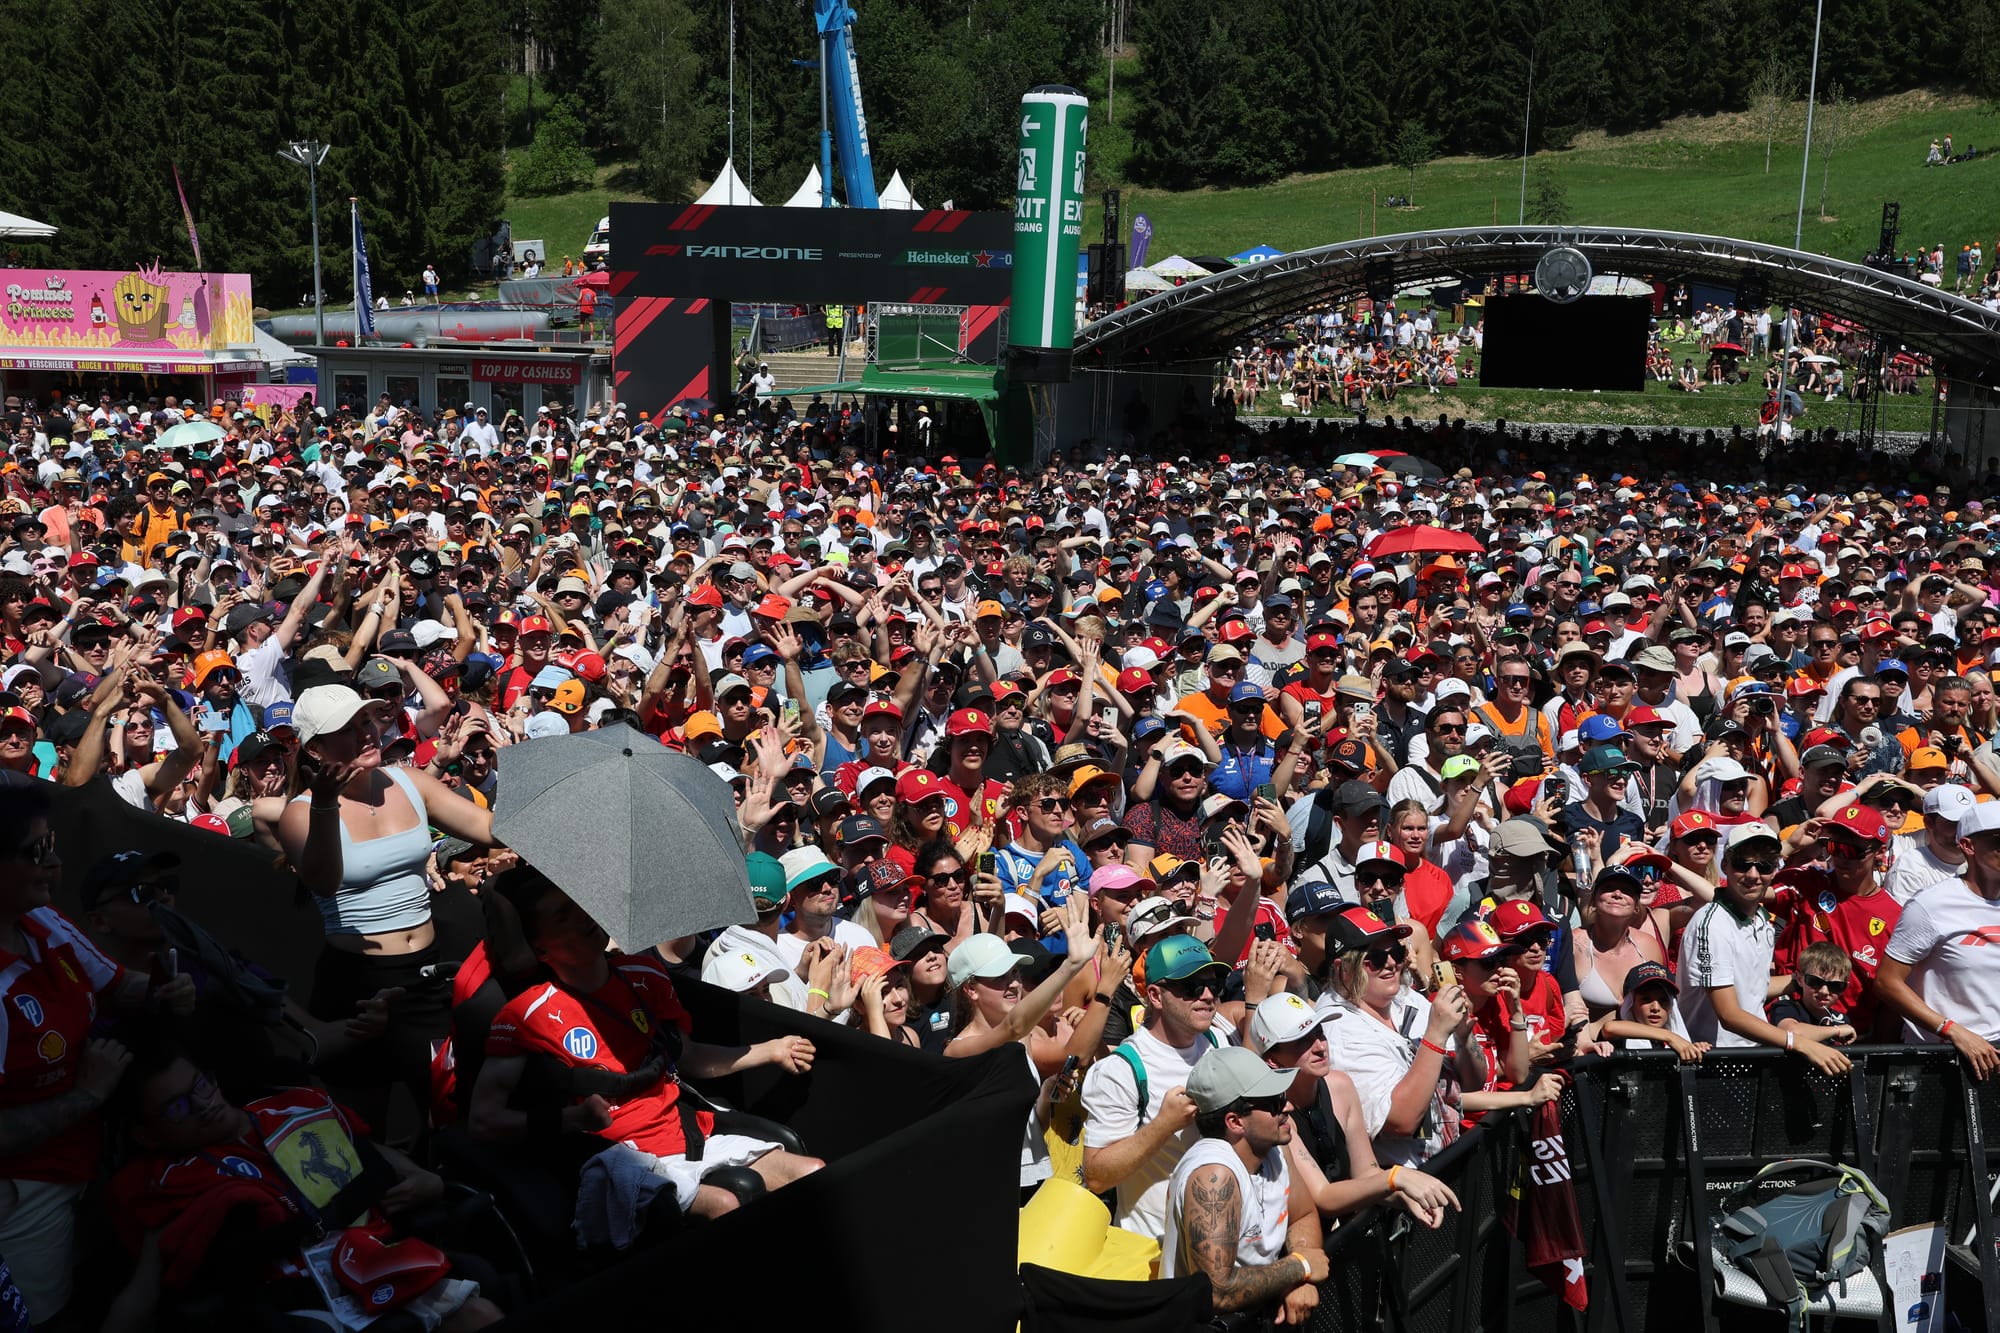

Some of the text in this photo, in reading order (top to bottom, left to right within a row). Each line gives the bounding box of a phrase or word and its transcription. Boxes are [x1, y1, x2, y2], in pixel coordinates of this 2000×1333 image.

[843, 24, 870, 158] FELBERMAYR
[1015, 198, 1046, 218] XIT
[686, 245, 823, 261] FANZONE
[907, 251, 969, 264] Heineken
[6, 284, 73, 303] Pommes
[7, 303, 75, 320] Princess
[16, 360, 25, 368] 20
[28, 360, 74, 369] VERSCHIEDENE
[113, 362, 144, 371] TOPPINGS
[174, 364, 196, 373] LOADED
[480, 364, 573, 380] TOP UP CASHLESS
[567, 1028, 592, 1059] hp
[1690, 1112, 1698, 1152] PRODUCTIONS
[1970, 1105, 1979, 1144] PRODUCTIONS
[1706, 1182, 1731, 1190] EMAK
